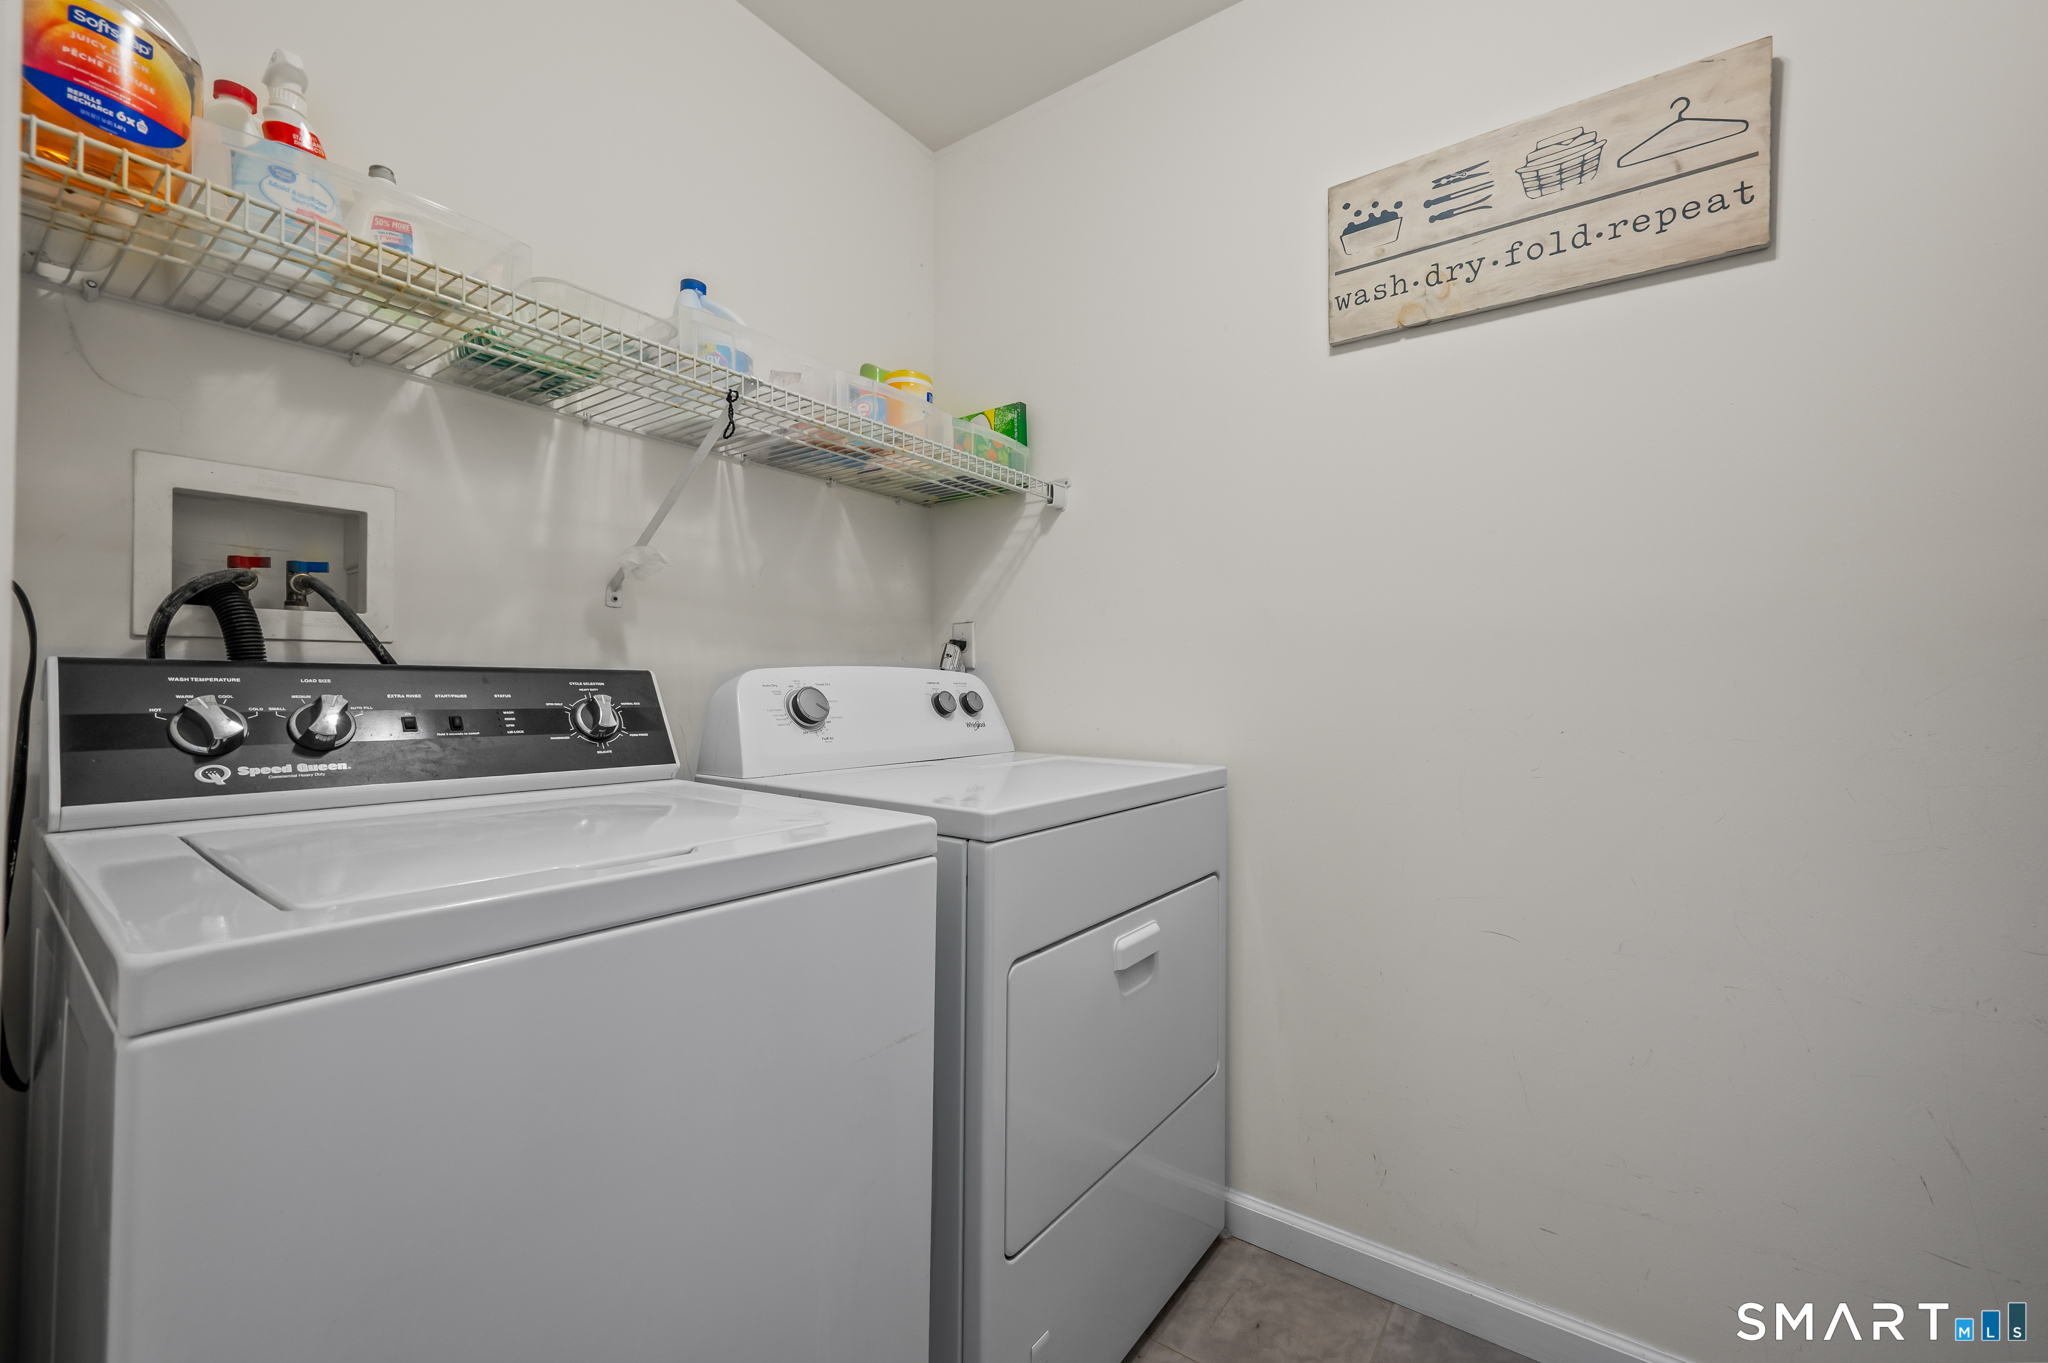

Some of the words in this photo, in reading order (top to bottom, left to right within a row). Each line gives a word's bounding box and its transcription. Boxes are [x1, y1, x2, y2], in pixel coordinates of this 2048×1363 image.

[70, 31, 107, 50] JUICY
[73, 9, 153, 55] Softsap
[62, 45, 104, 68] PÊCHE
[67, 86, 102, 106] REFILLS
[67, 92, 114, 117] RECHARGE
[116, 110, 136, 128] 6x
[268, 180, 290, 193] Mold
[374, 217, 390, 228] 50%
[391, 221, 410, 232] MORE
[1334, 273, 1408, 311] wash
[1425, 256, 1486, 287] dry
[1505, 223, 1592, 267] fold
[1608, 180, 1756, 241] repeat
[237, 764, 292, 777] Speed
